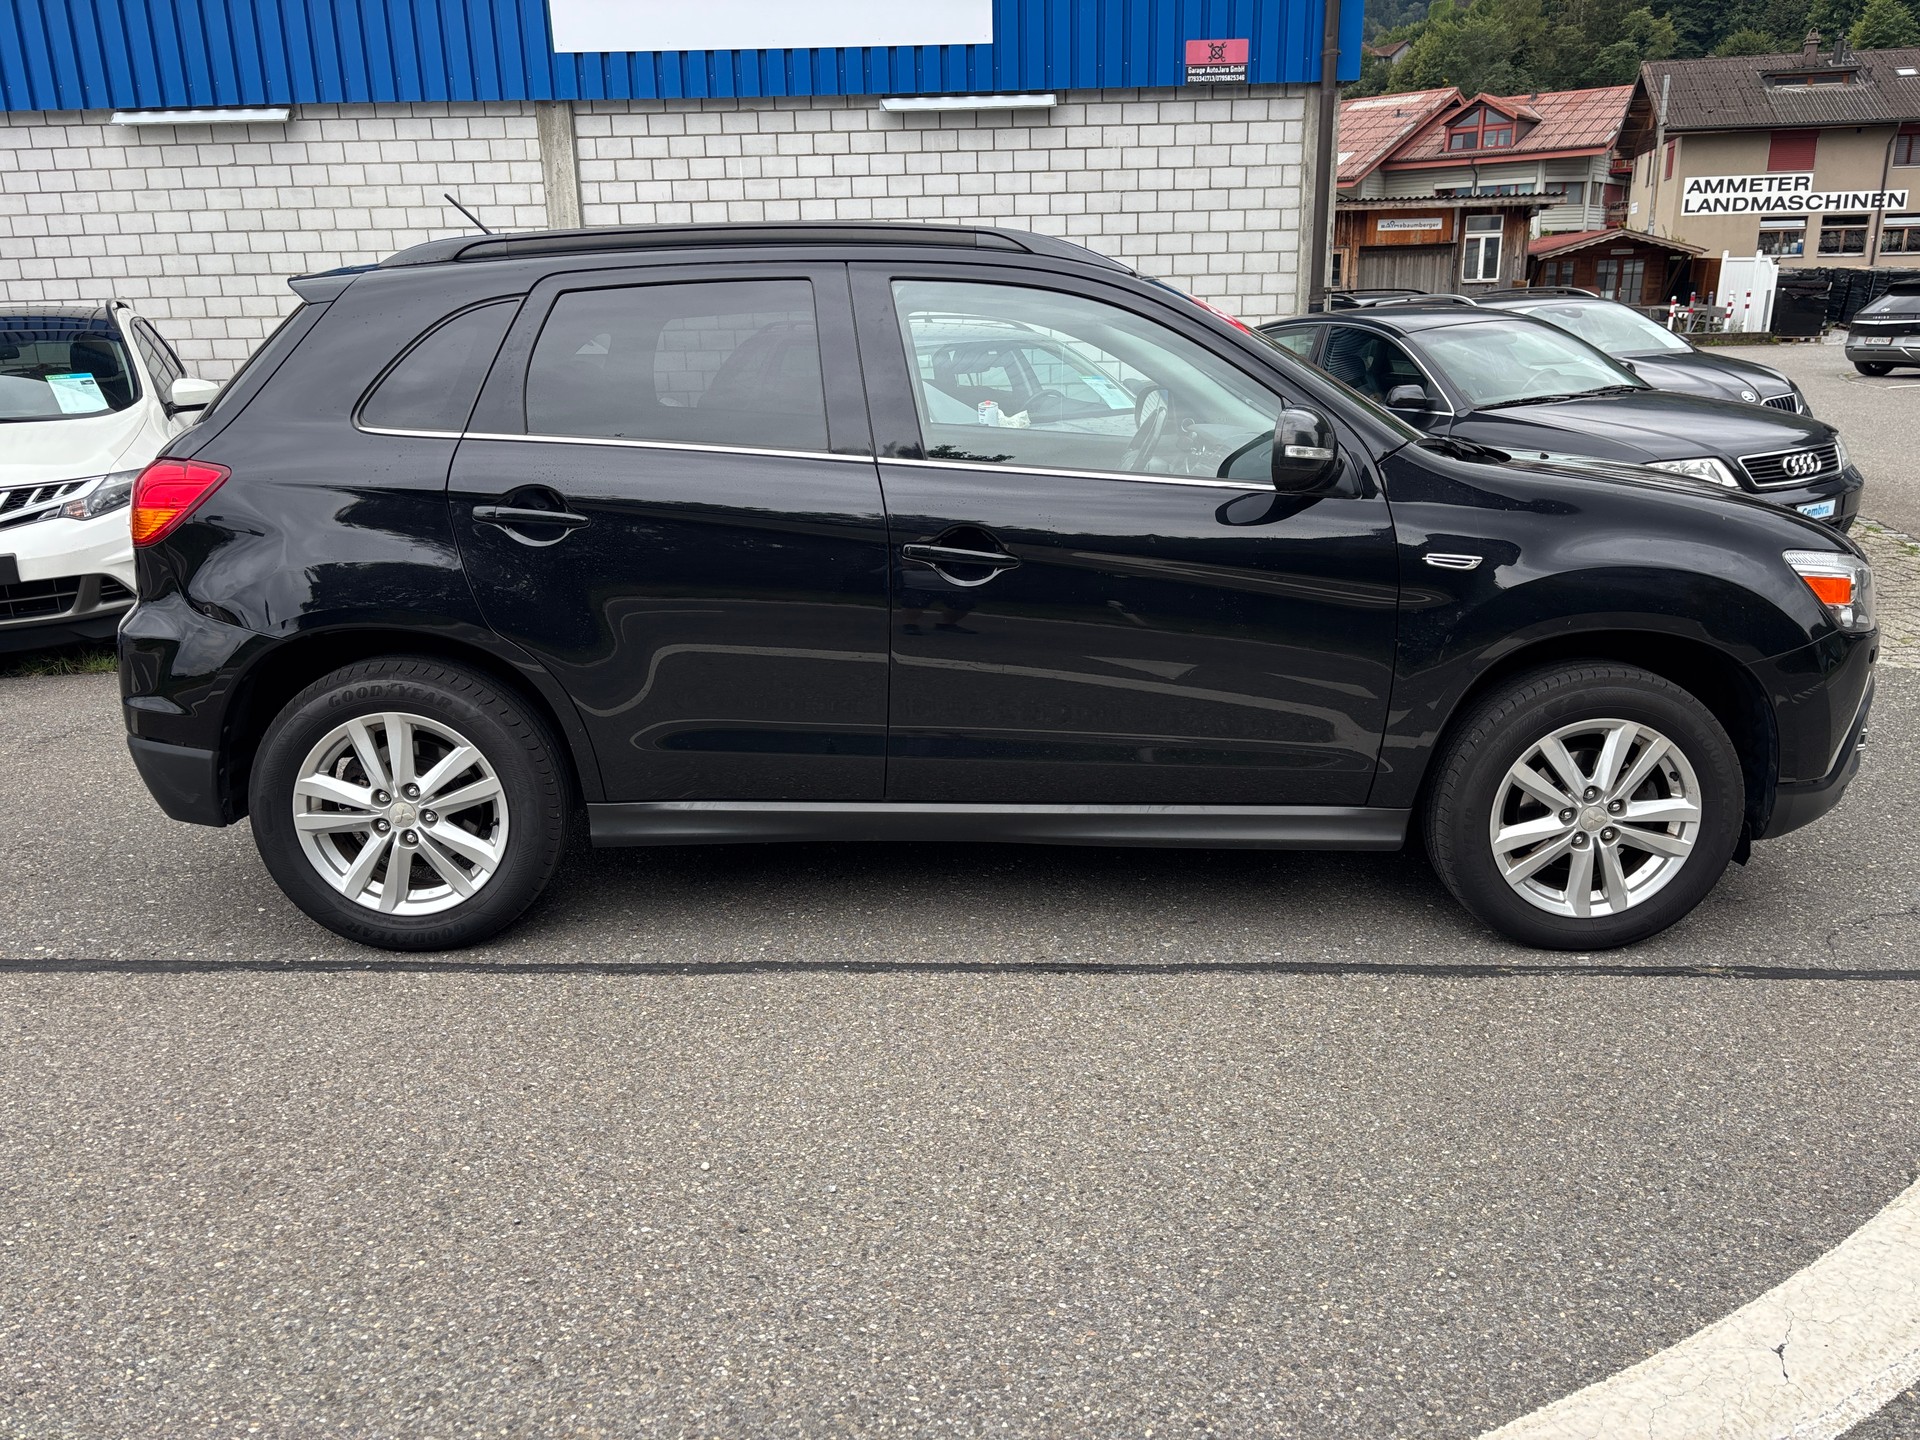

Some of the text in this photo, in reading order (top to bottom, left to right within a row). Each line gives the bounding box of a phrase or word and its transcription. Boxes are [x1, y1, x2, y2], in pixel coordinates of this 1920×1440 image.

[1187, 66, 1206, 74] Garage
[1230, 65, 1245, 73] GmbH
[1687, 176, 1810, 194] AMMETER
[1684, 192, 1906, 213] LANDMASCHINEN
